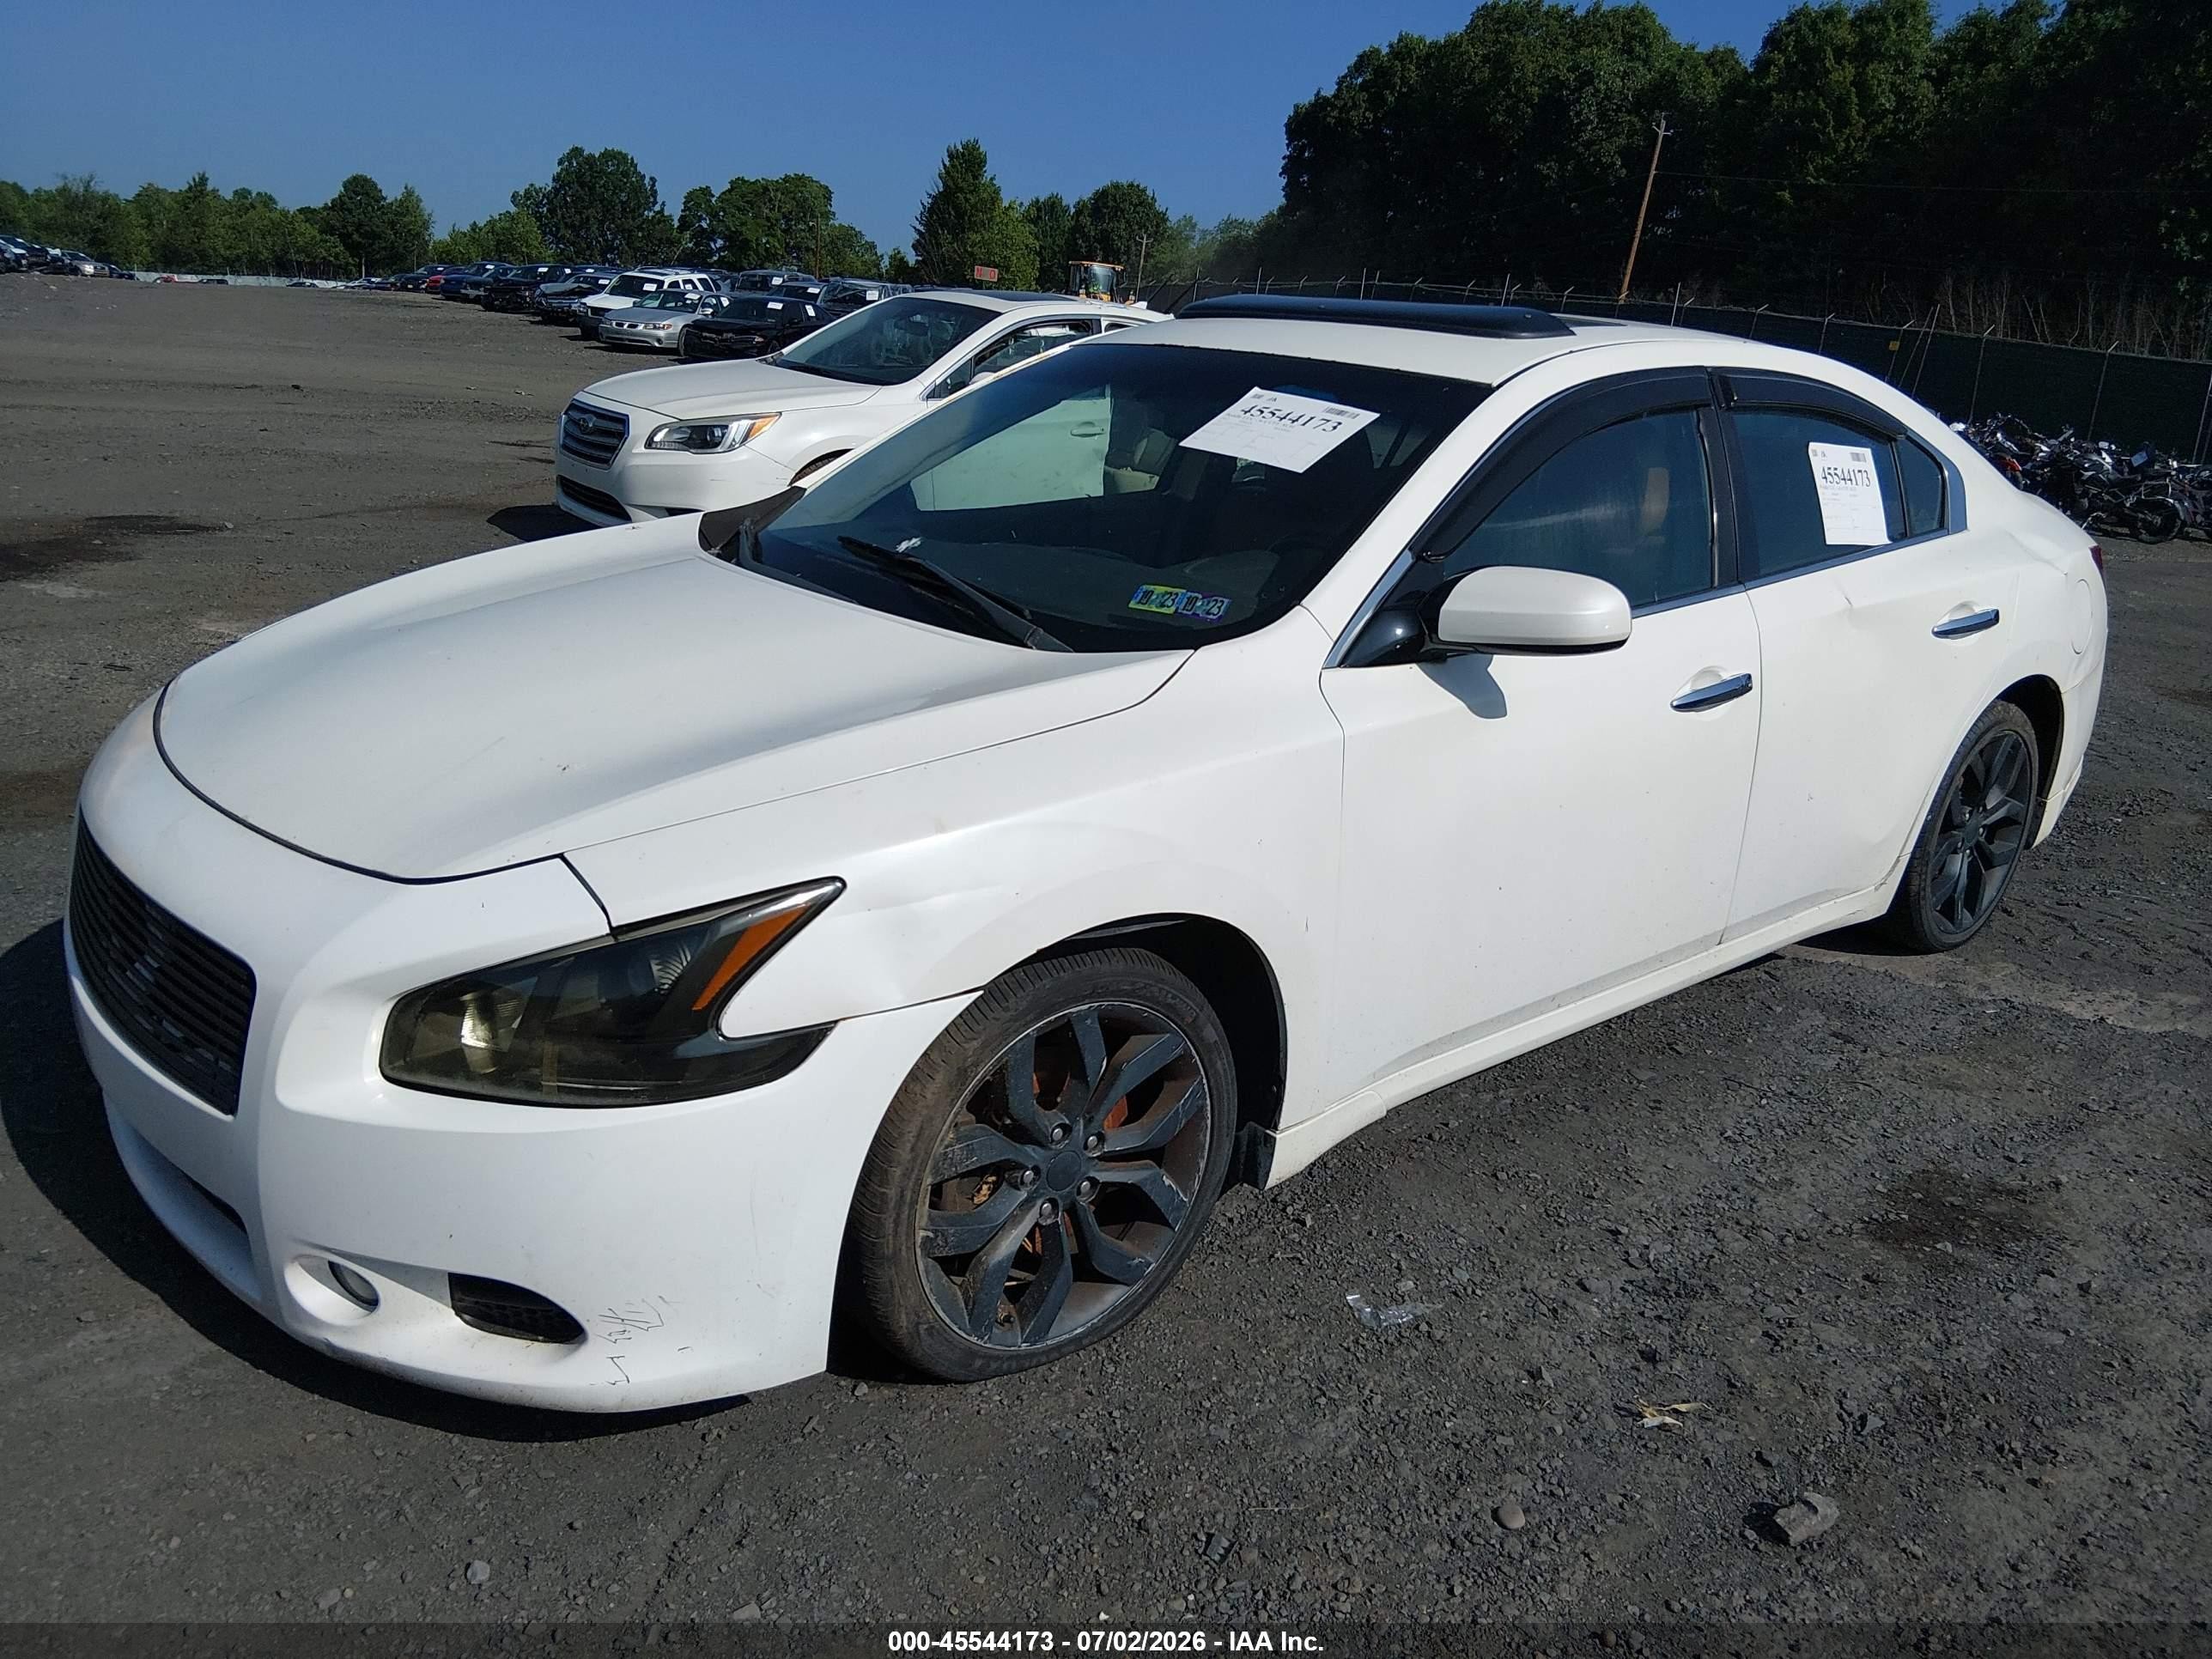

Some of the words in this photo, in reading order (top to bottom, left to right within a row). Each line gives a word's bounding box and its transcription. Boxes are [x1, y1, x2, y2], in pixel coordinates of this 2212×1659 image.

[1241, 404, 1343, 433] 45544173
[1820, 466, 1871, 488] 45544173
[1159, 591, 1180, 608] 23
[1206, 599, 1225, 617] 23
